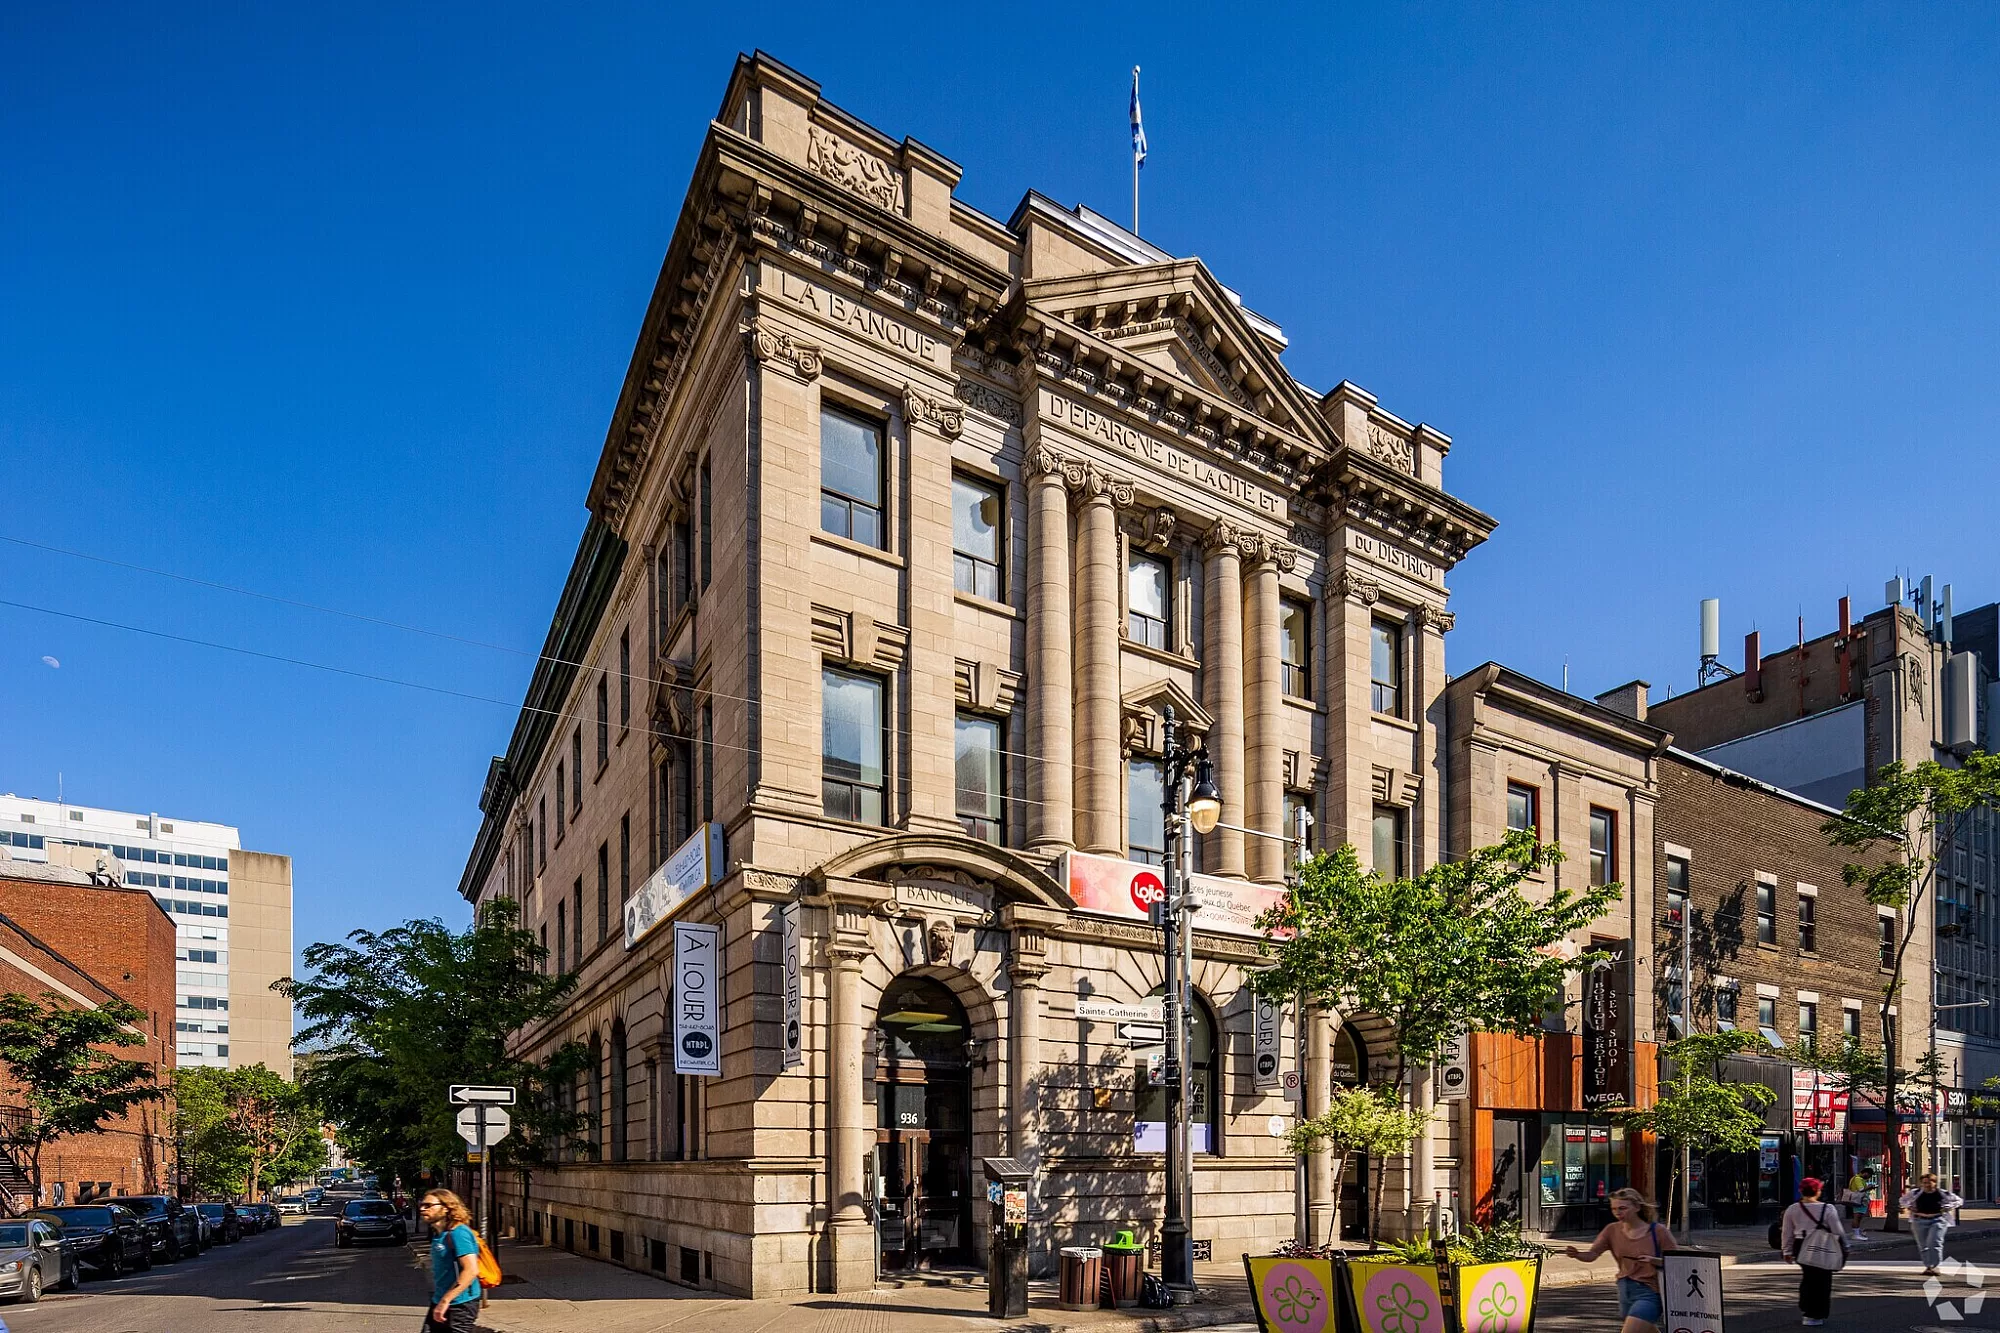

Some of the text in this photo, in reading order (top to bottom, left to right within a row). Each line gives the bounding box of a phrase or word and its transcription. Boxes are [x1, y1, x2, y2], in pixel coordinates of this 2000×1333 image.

[782, 272, 935, 362] LA BANQUE
[1167, 452, 1189, 475] DE
[1194, 463, 1216, 487] LA
[1218, 469, 1255, 504] CITE
[1261, 491, 1279, 512] ET
[1355, 535, 1436, 581] DU DISTRICT
[906, 884, 974, 907] BANQUE
[1227, 900, 1251, 912] Québec
[683, 934, 710, 1021] À LOUER
[787, 944, 797, 1010] LOUER
[1079, 1006, 1148, 1018] Sainte-Catherine
[1594, 982, 1605, 1031] BOUTIQUE
[1608, 989, 1617, 1067] SEX SHOP
[900, 1112, 918, 1124] 936
[1585, 1093, 1625, 1103] WEGA
[1690, 1311, 1720, 1320] PIÉTONNE
